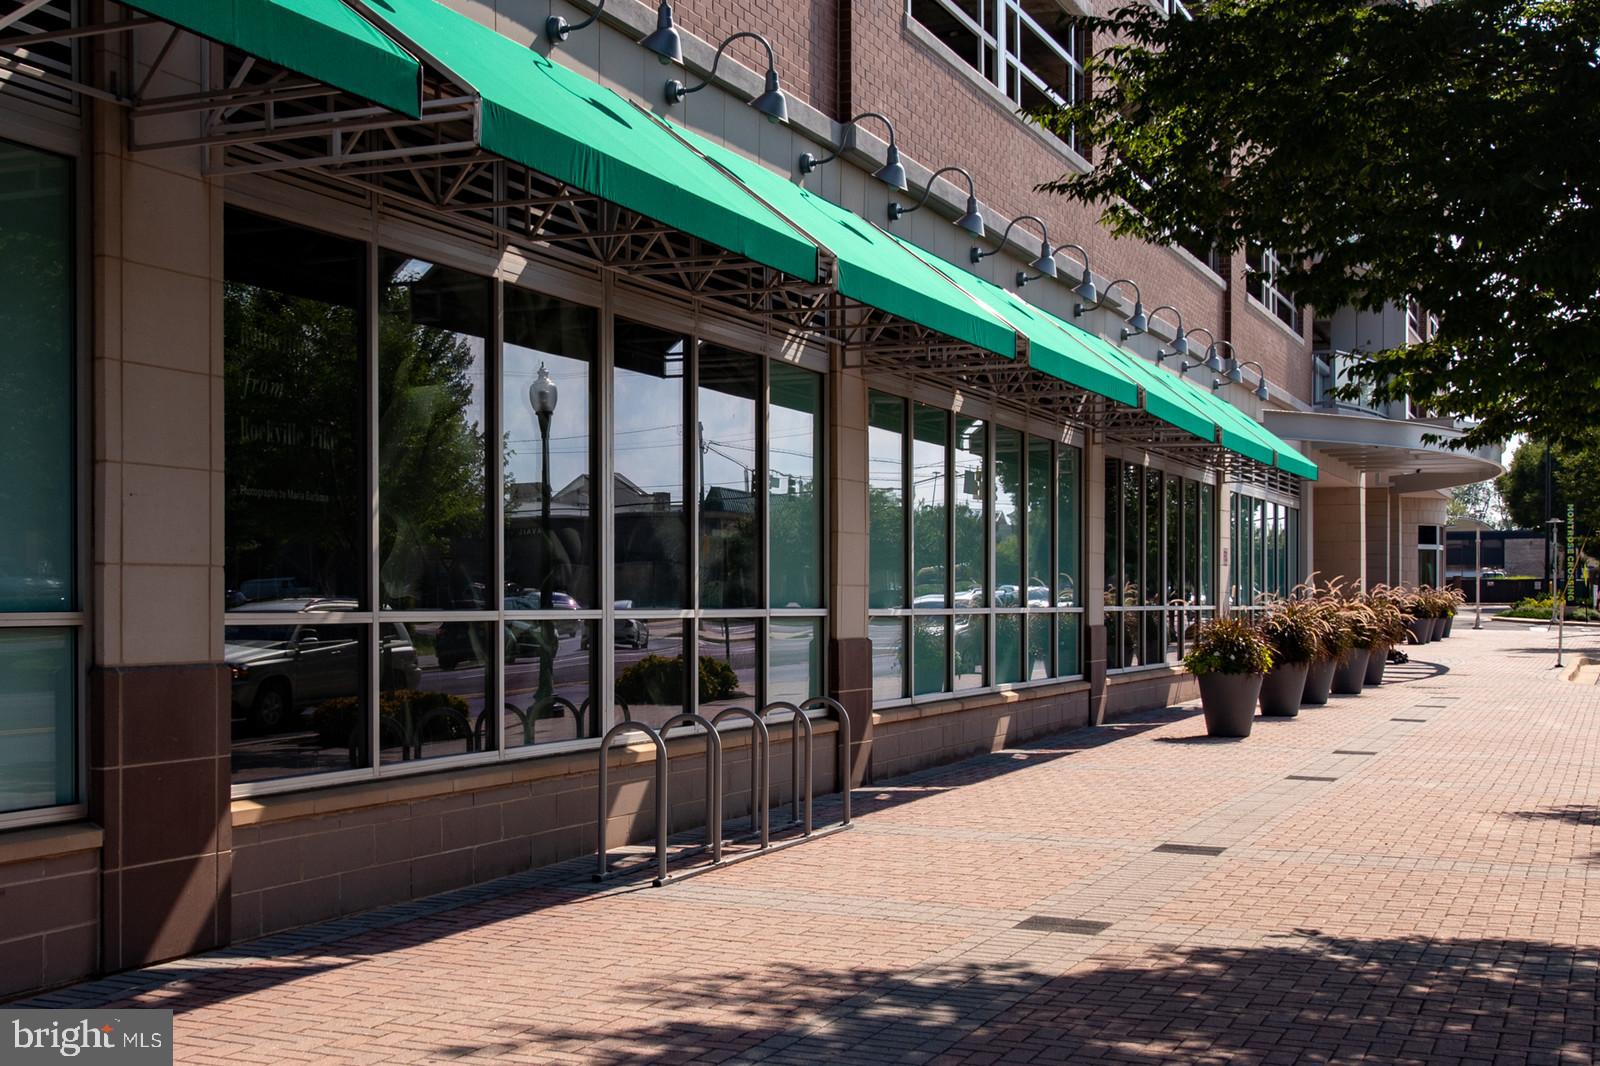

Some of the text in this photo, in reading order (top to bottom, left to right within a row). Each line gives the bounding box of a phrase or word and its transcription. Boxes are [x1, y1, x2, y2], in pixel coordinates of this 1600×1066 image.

[240, 369, 284, 399] from
[240, 416, 304, 446] Rockville
[1566, 504, 1575, 601] MONTROSE CROSSING
